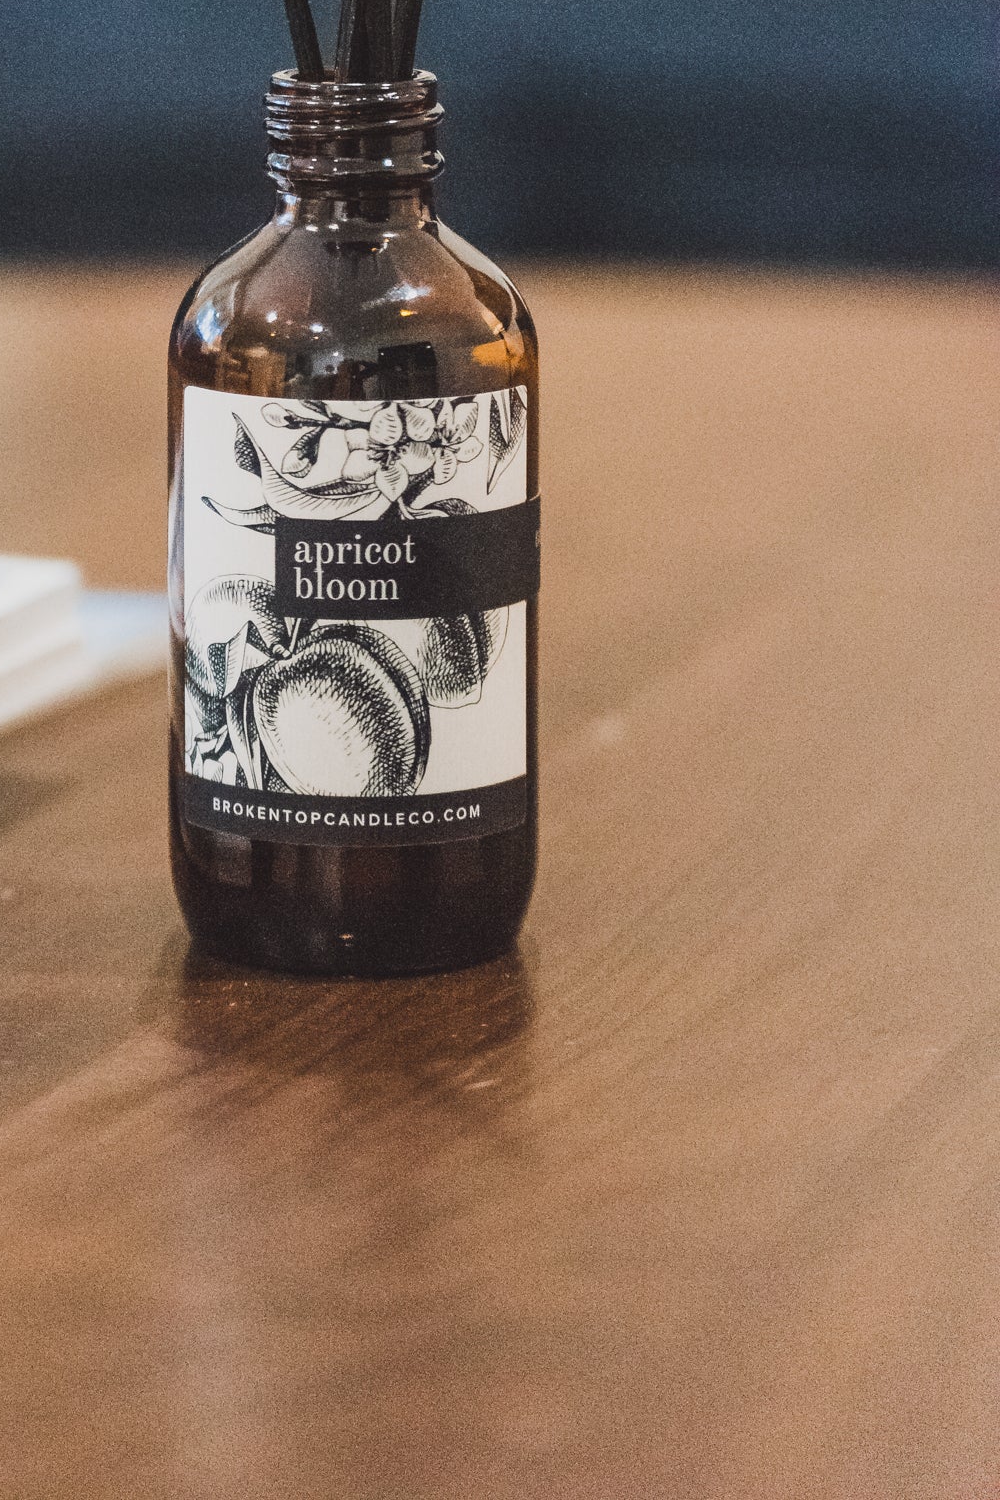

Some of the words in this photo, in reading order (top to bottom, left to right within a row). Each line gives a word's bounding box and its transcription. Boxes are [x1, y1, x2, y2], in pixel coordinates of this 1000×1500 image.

[293, 533, 417, 572] apricot
[293, 566, 400, 601] bloom
[212, 796, 481, 827] BROKENTOPCANDLECO.COM
